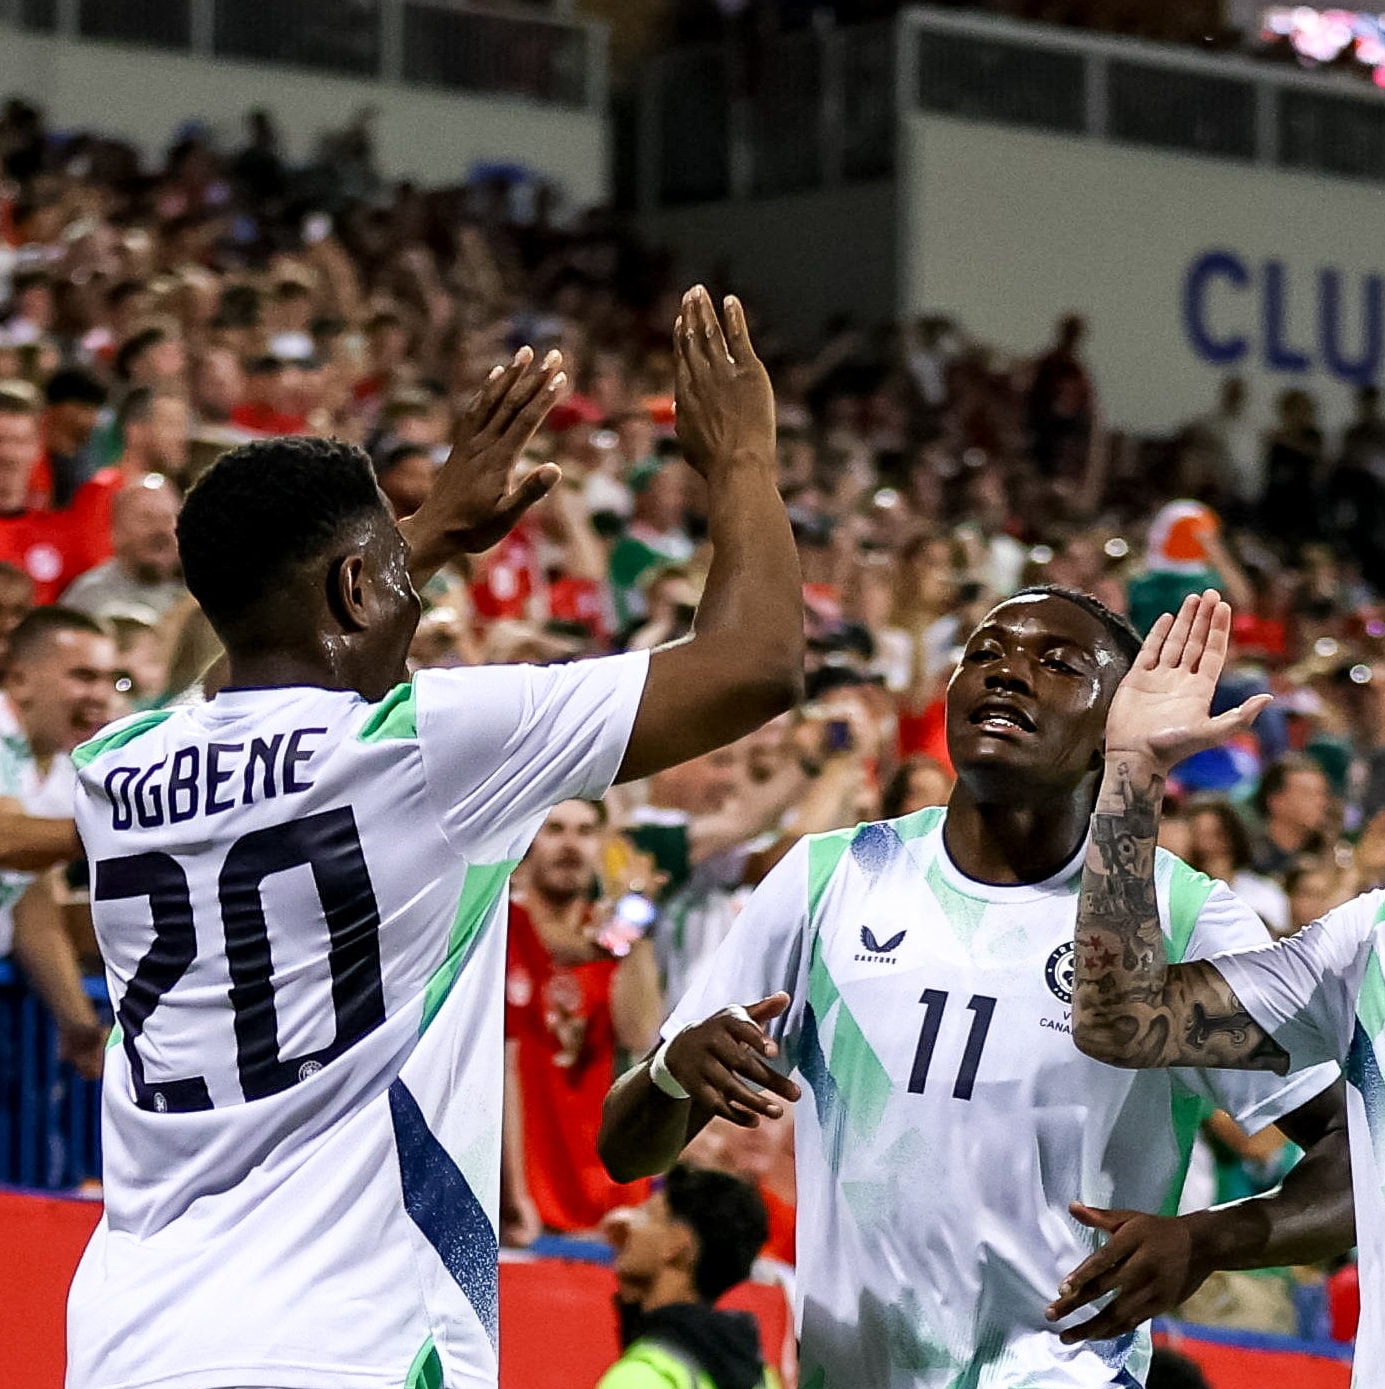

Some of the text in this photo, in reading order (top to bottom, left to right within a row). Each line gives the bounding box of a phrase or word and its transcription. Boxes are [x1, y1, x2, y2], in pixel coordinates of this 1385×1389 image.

[103, 727, 327, 831] OGBENE
[94, 805, 387, 1114] 20
[907, 988, 998, 1101] 11
[1039, 1017, 1074, 1034] CANA
